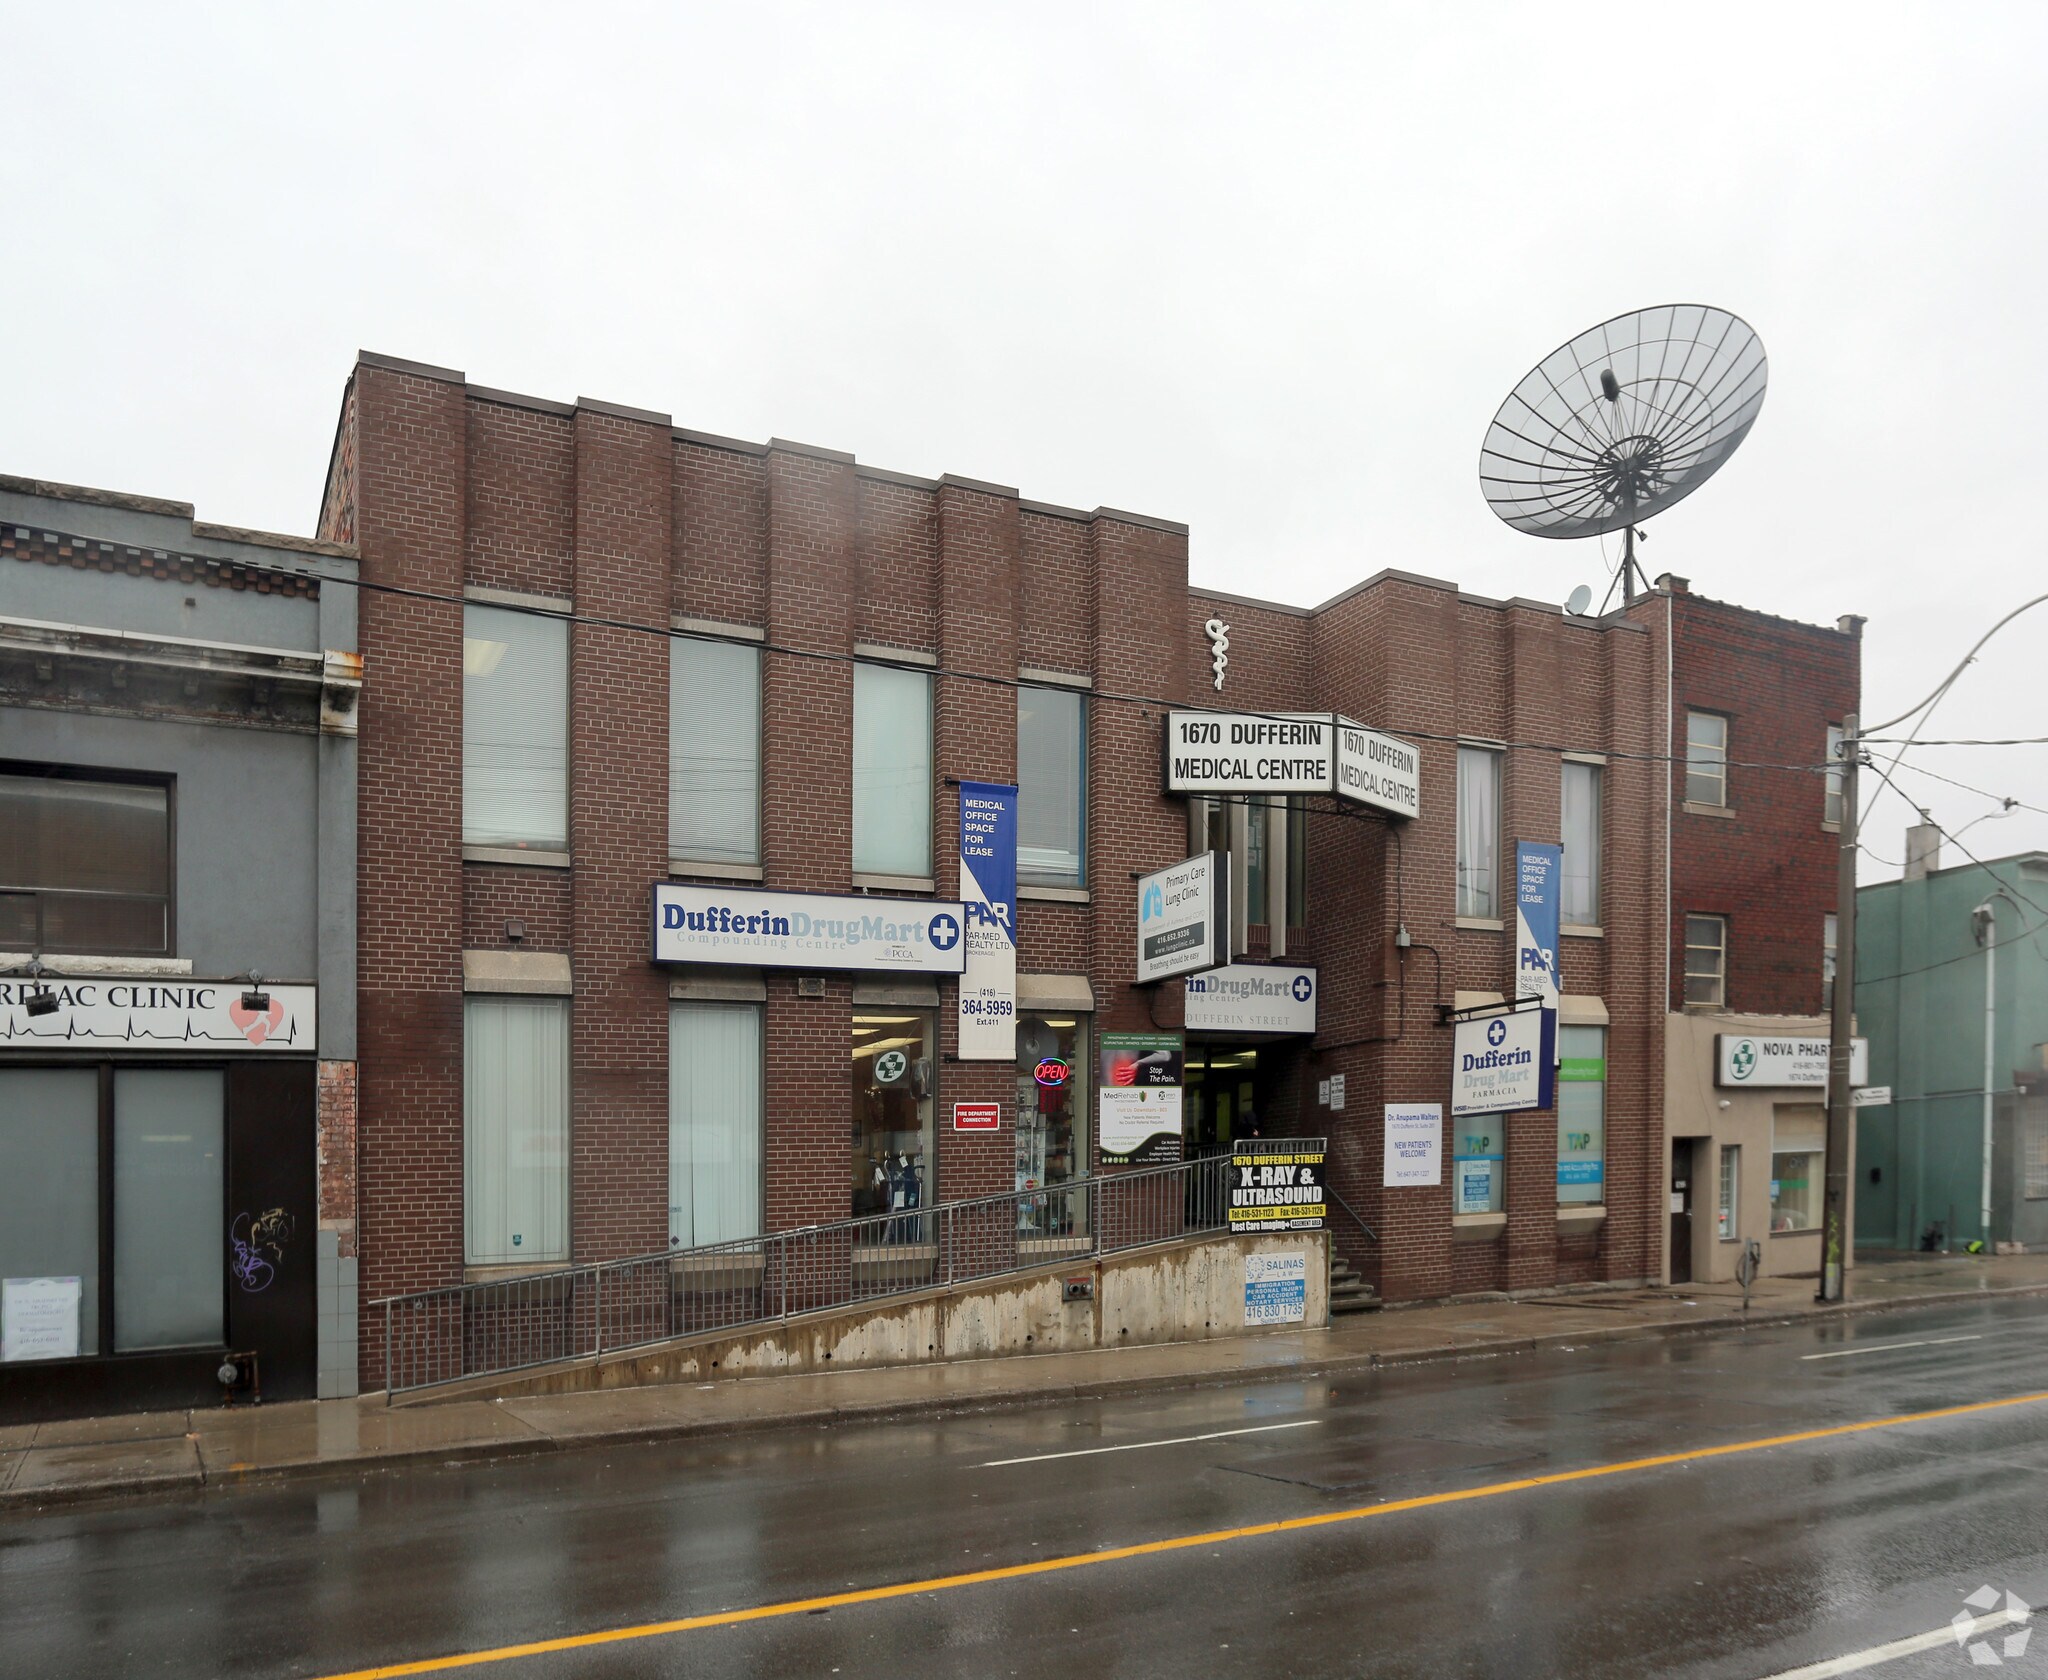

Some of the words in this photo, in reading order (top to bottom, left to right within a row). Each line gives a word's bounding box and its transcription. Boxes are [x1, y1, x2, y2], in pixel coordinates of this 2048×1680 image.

[1180, 723, 1220, 744] 1670
[1231, 724, 1322, 744] DUFFERIN
[1343, 730, 1364, 756] 1670
[1369, 739, 1413, 774] DUFFERIN
[1175, 758, 1252, 779] MEDICAL
[1257, 759, 1326, 780] CENTRE
[1341, 763, 1380, 796] MEDICAL
[1382, 777, 1416, 806] CENTRE
[966, 799, 1005, 810] MEDICAL
[965, 811, 998, 821] OFFICE
[965, 823, 994, 833] SPACE
[965, 835, 984, 844] FOR
[965, 847, 994, 856] LEASE
[1522, 855, 1552, 866] MEDICAL
[1522, 865, 1546, 874] OFFICE
[1166, 872, 1189, 888] Primary
[1190, 867, 1205, 880] Care
[1522, 875, 1544, 884] SPACE
[1166, 893, 1180, 906] Lung
[1182, 885, 1199, 900] Clinic
[1522, 895, 1543, 903] LEASE
[966, 901, 1011, 928] PAR
[677, 932, 788, 949] Compounding
[796, 938, 846, 950] Centre
[996, 942, 1012, 950] LTD.
[892, 950, 914, 958] PCCA
[1150, 960, 1169, 970] Breathing
[1170, 954, 1183, 965] should
[1184, 954, 1189, 962] be
[1521, 948, 1554, 972] PAR
[107, 986, 216, 1010] CLINIC
[980, 988, 995, 997] (416)
[1210, 994, 1241, 1003] Centre
[962, 1000, 1012, 1015] 364-5959
[1186, 1013, 1243, 1024] DUFFERIN
[1250, 1015, 1290, 1025] STREET
[1764, 1043, 1794, 1056] NOVA
[1462, 1047, 1531, 1072] Dufferin
[1036, 1065, 1066, 1078] OPEN
[1149, 1066, 1163, 1074] Stop
[1464, 1074, 1495, 1089] Drug
[1498, 1067, 1529, 1084] Mart
[1472, 1087, 1517, 1098] FARMACIA
[1396, 1114, 1419, 1122] Anupama
[1408, 1141, 1432, 1149] PATIENTS
[1232, 1156, 1252, 1165] 1670
[1253, 1155, 1293, 1165] DUFFERIN
[1294, 1154, 1324, 1164] STREET
[1241, 1166, 1296, 1186] X-RAY
[1300, 1168, 1314, 1184] &
[1232, 1186, 1322, 1206] ULTRASOUND
[1232, 1222, 1245, 1231] Best
[1246, 1221, 1260, 1230] Care
[1261, 1220, 1285, 1230] Imaging
[1267, 1259, 1304, 1270] SALINAS
[1247, 1307, 1262, 1318] 416
[1264, 1305, 1280, 1317] 830
[1283, 1303, 1302, 1315] 1735
